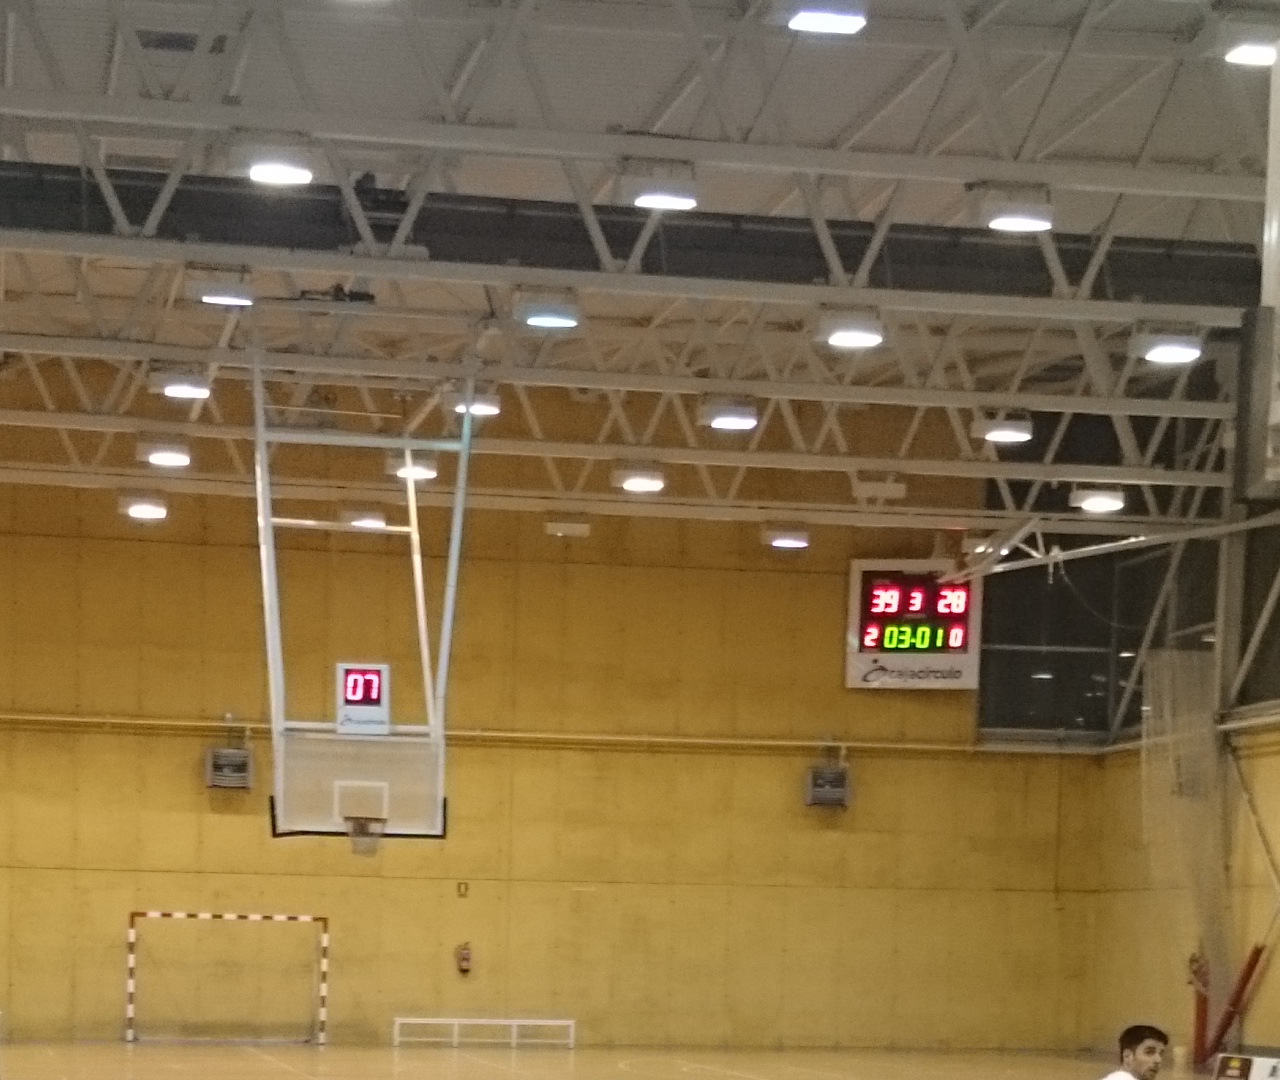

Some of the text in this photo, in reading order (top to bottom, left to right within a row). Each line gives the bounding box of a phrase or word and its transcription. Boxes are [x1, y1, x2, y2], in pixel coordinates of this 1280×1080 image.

[870, 589, 966, 613] 39 3 28
[863, 627, 879, 647] 2
[948, 627, 963, 647] 0
[346, 673, 379, 700] 07
